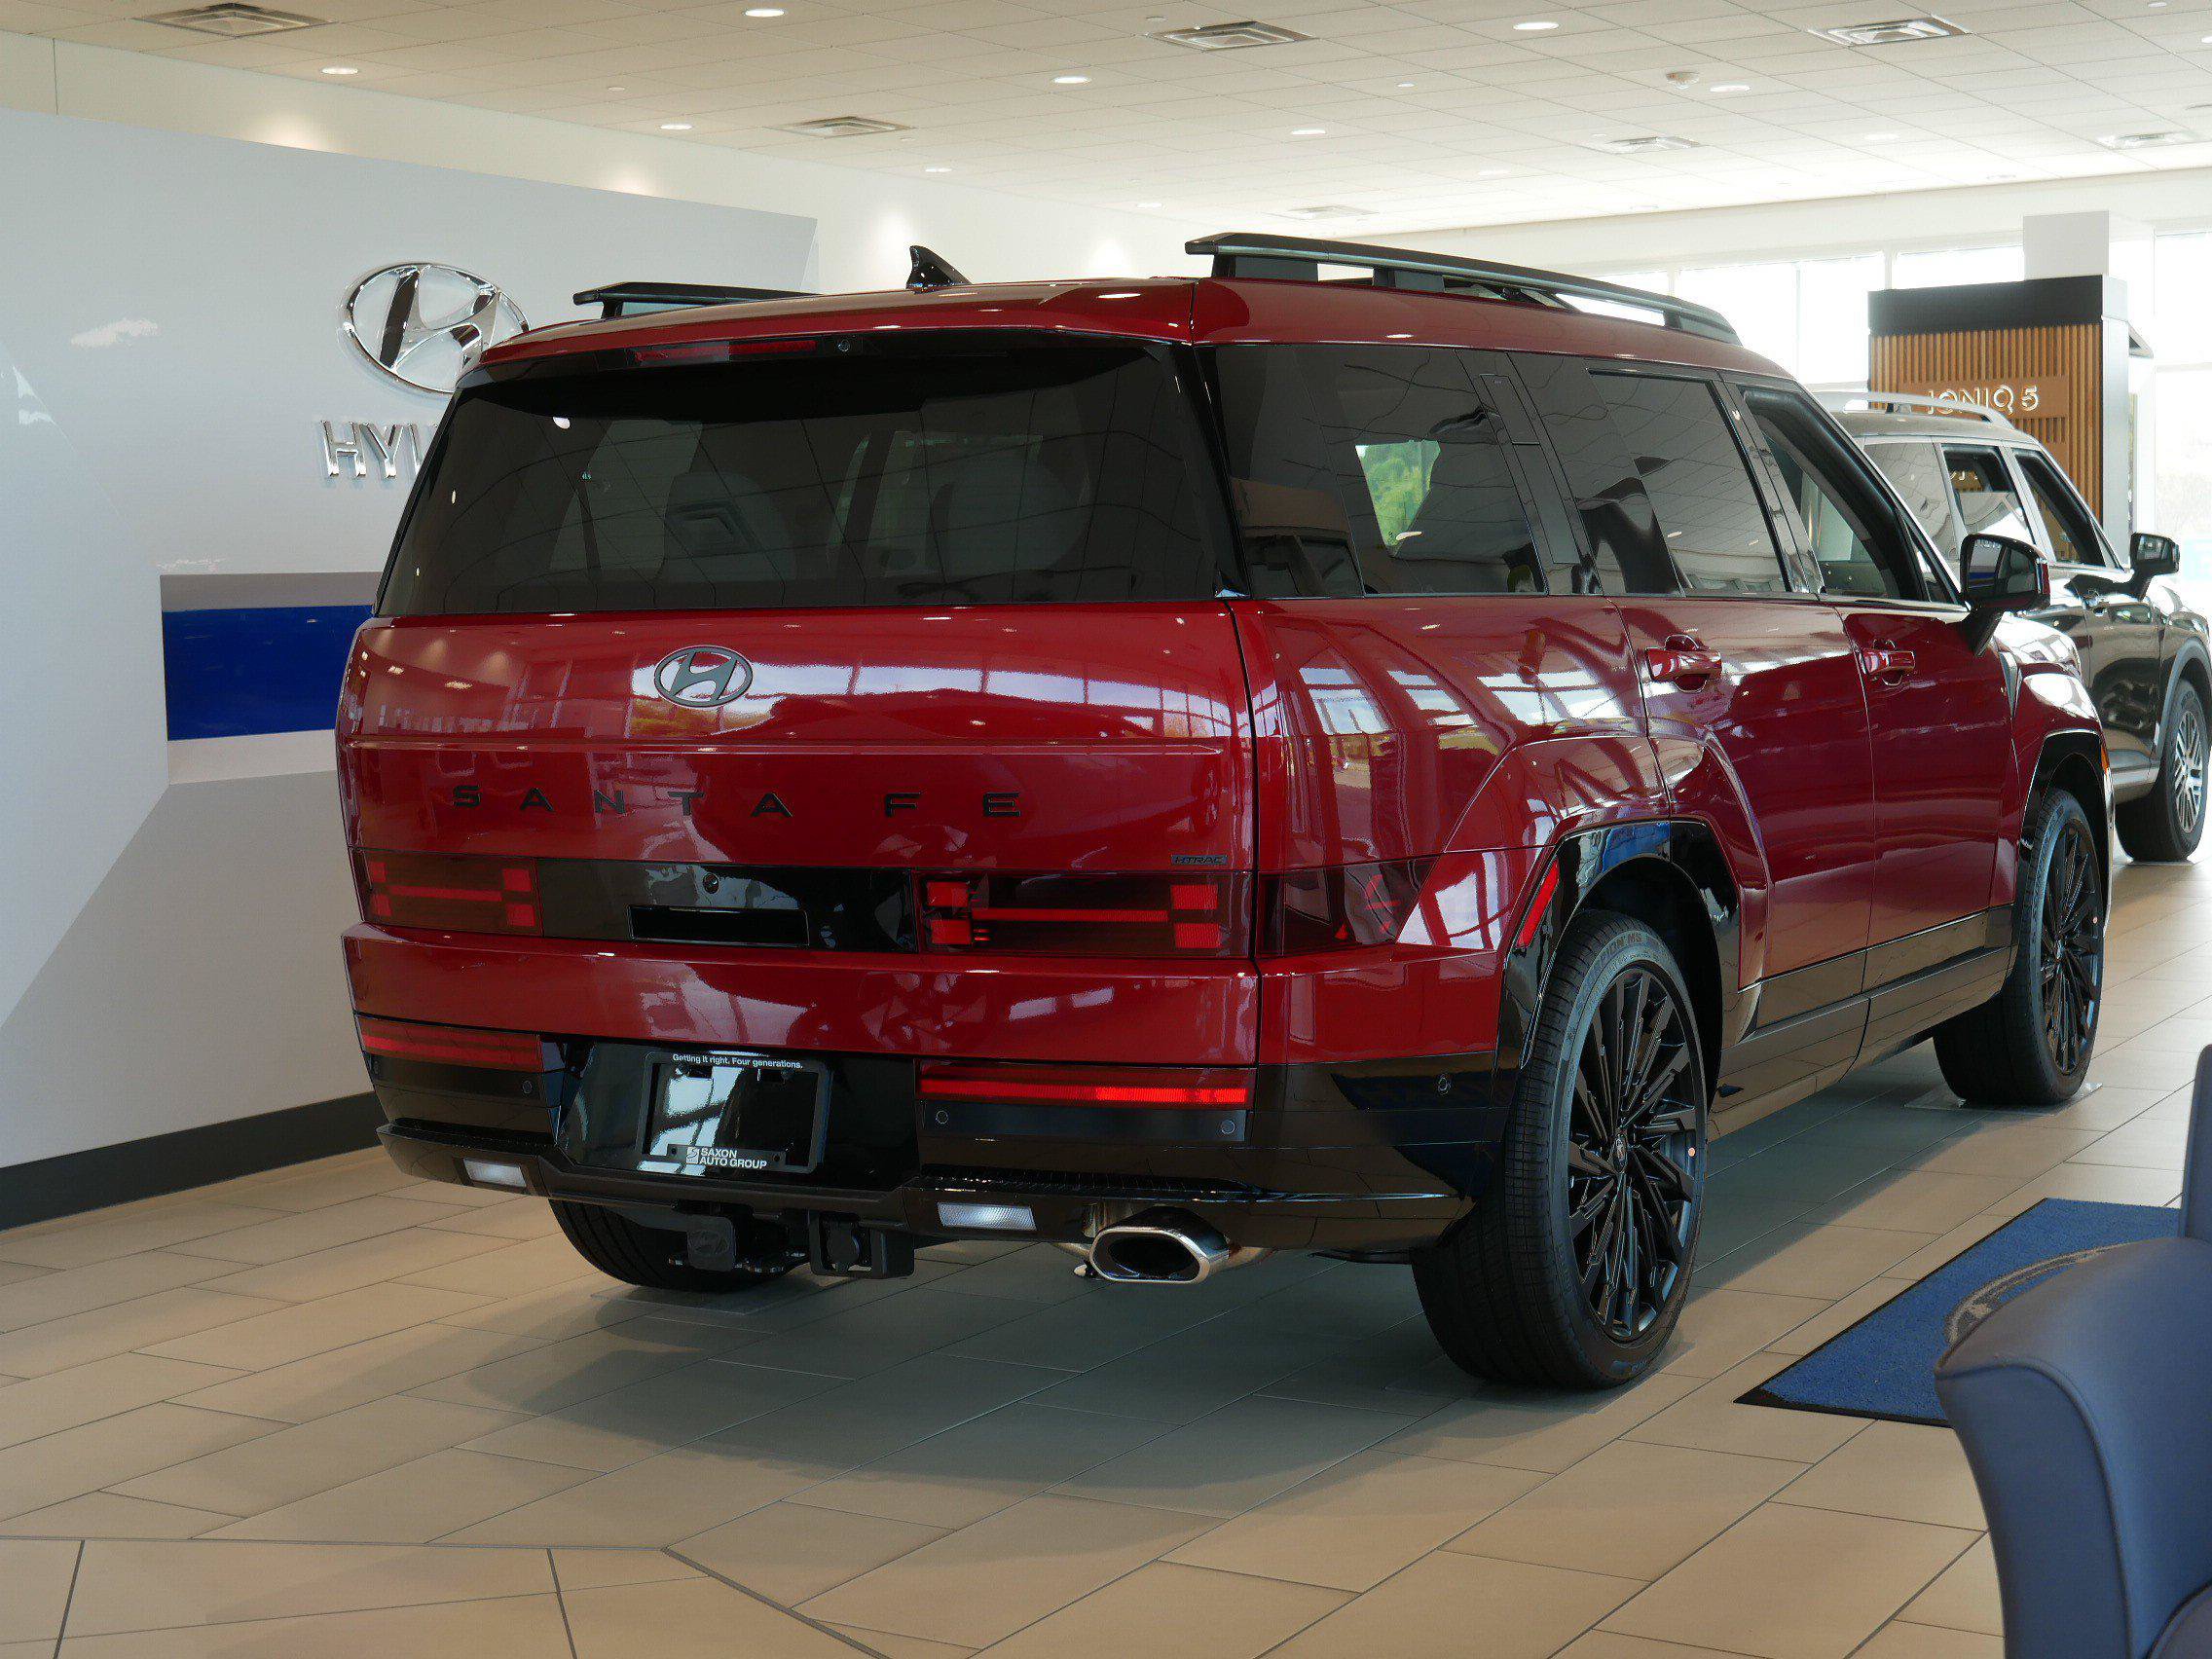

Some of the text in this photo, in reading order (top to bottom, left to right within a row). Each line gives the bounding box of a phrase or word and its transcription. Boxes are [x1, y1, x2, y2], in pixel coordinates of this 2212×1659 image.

[2020, 385, 2040, 412] 5
[452, 784, 1022, 820] SANTA FE
[672, 1053, 701, 1064] Getting
[709, 1055, 731, 1066] right.
[732, 1057, 751, 1066] Four
[752, 1057, 804, 1070] generations.
[700, 1147, 738, 1159] SAXON
[699, 1156, 768, 1169] AUTO GROUP
